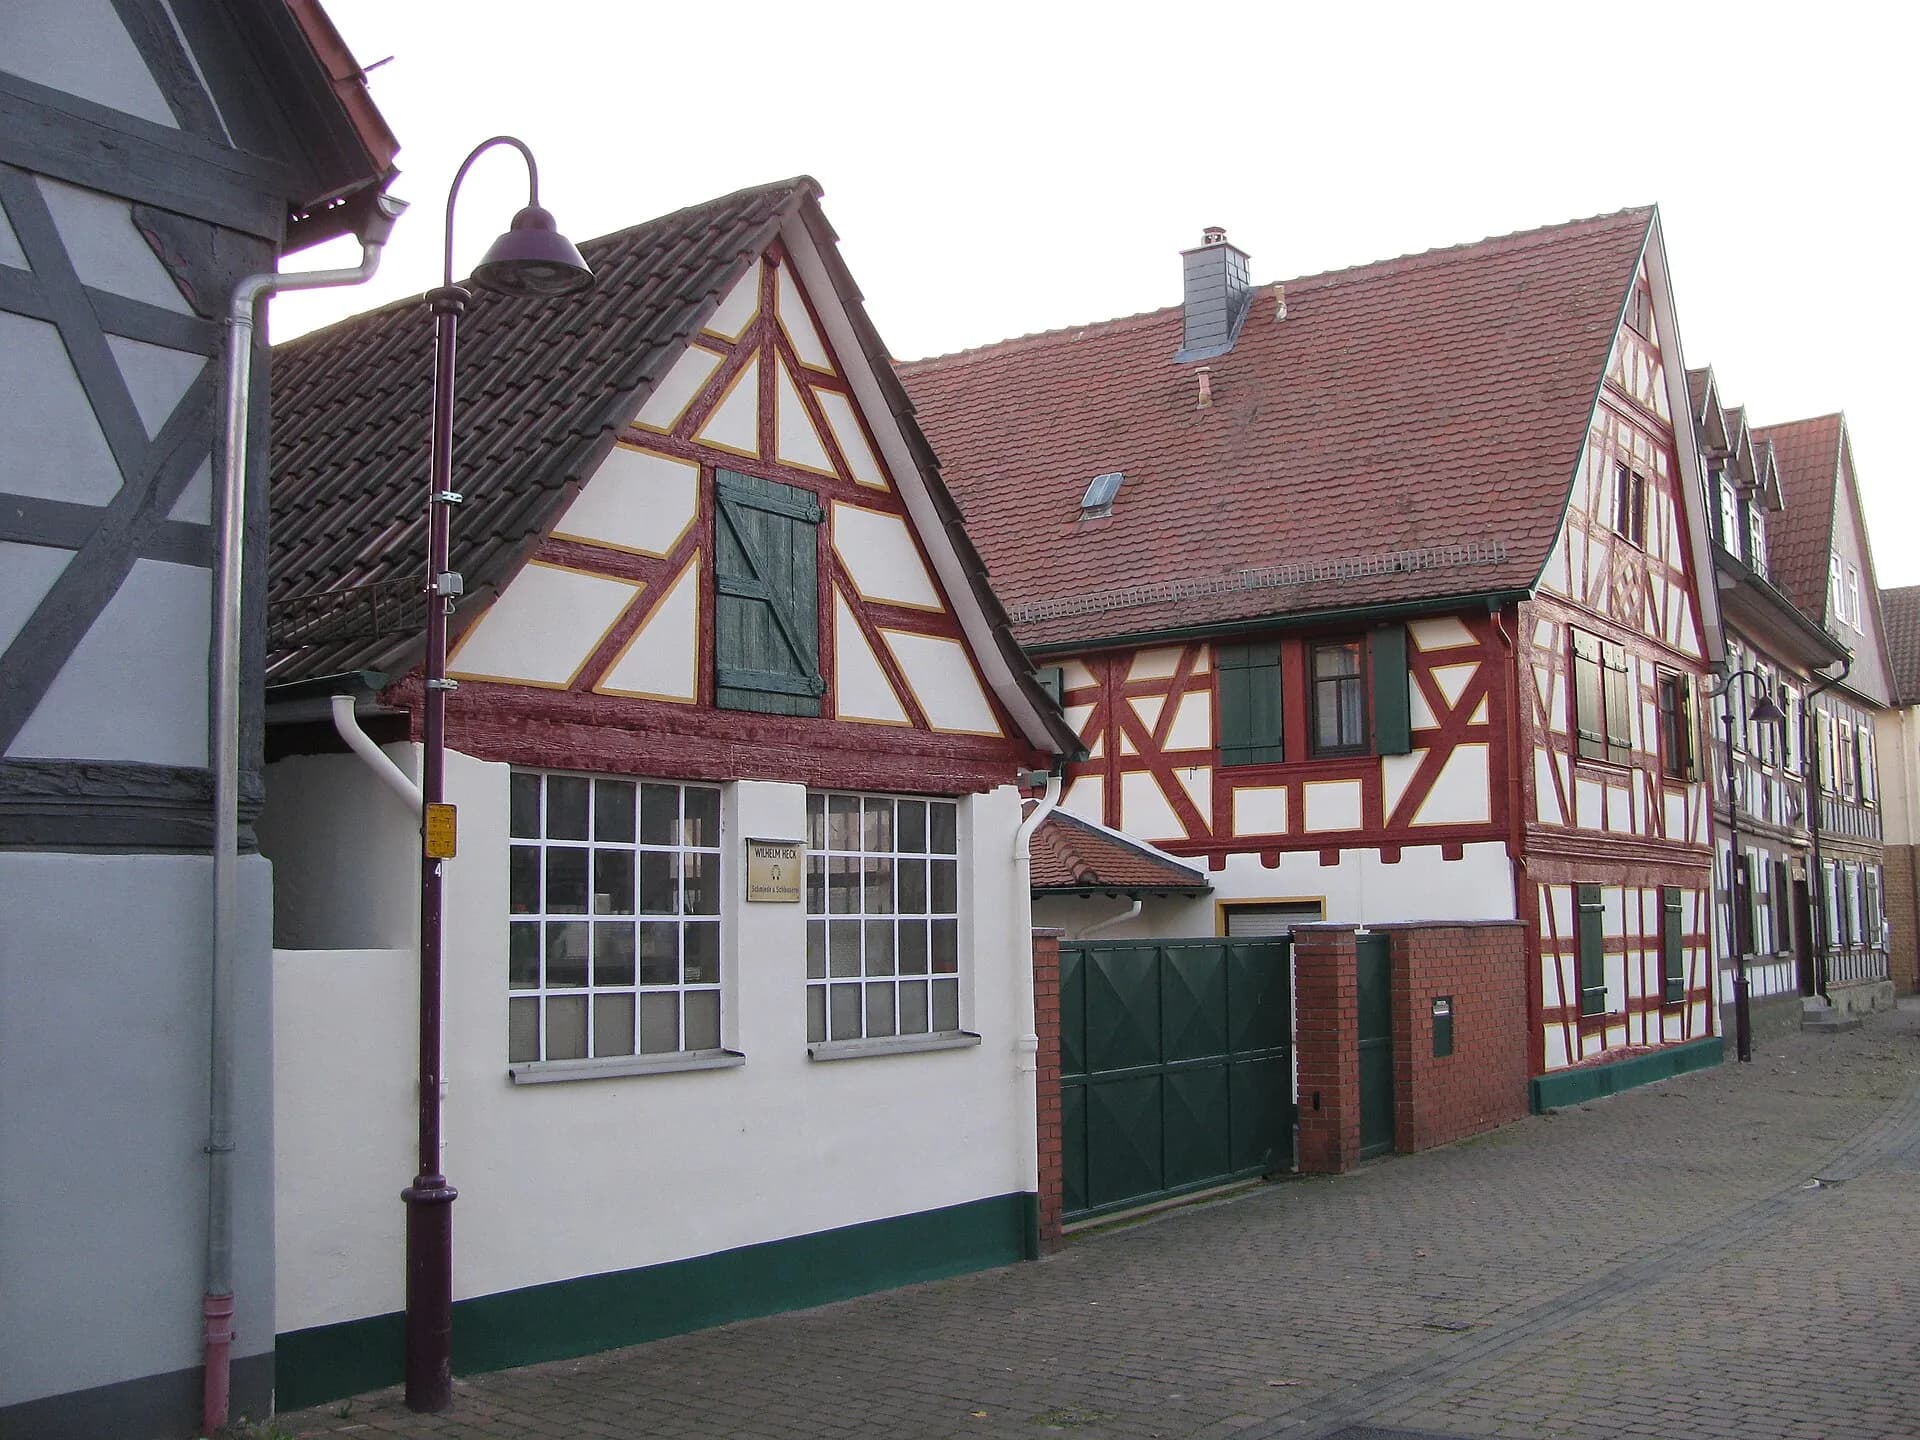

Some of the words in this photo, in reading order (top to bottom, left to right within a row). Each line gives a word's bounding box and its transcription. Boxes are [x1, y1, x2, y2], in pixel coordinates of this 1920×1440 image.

[754, 847, 781, 859] WILHELM
[782, 849, 797, 860] HECK
[434, 862, 442, 877] 4
